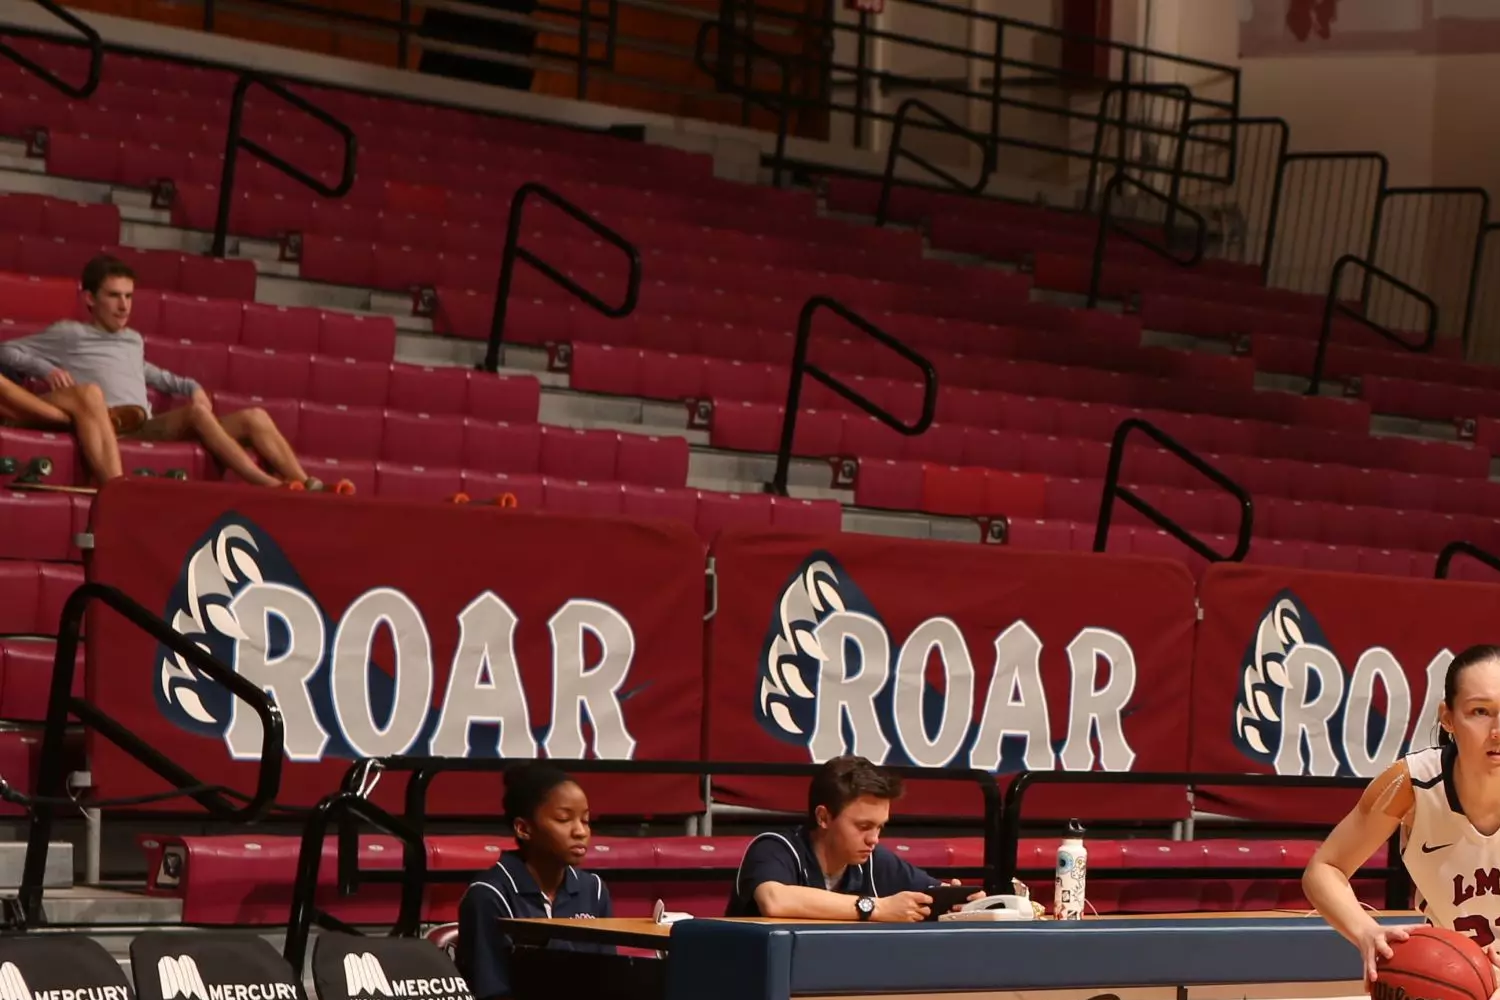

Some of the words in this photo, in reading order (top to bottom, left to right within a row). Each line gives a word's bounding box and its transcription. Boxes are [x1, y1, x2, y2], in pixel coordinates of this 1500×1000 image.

[223, 581, 637, 762] ROAR
[807, 610, 1137, 772] ROAR
[392, 976, 470, 996] MERCUR
